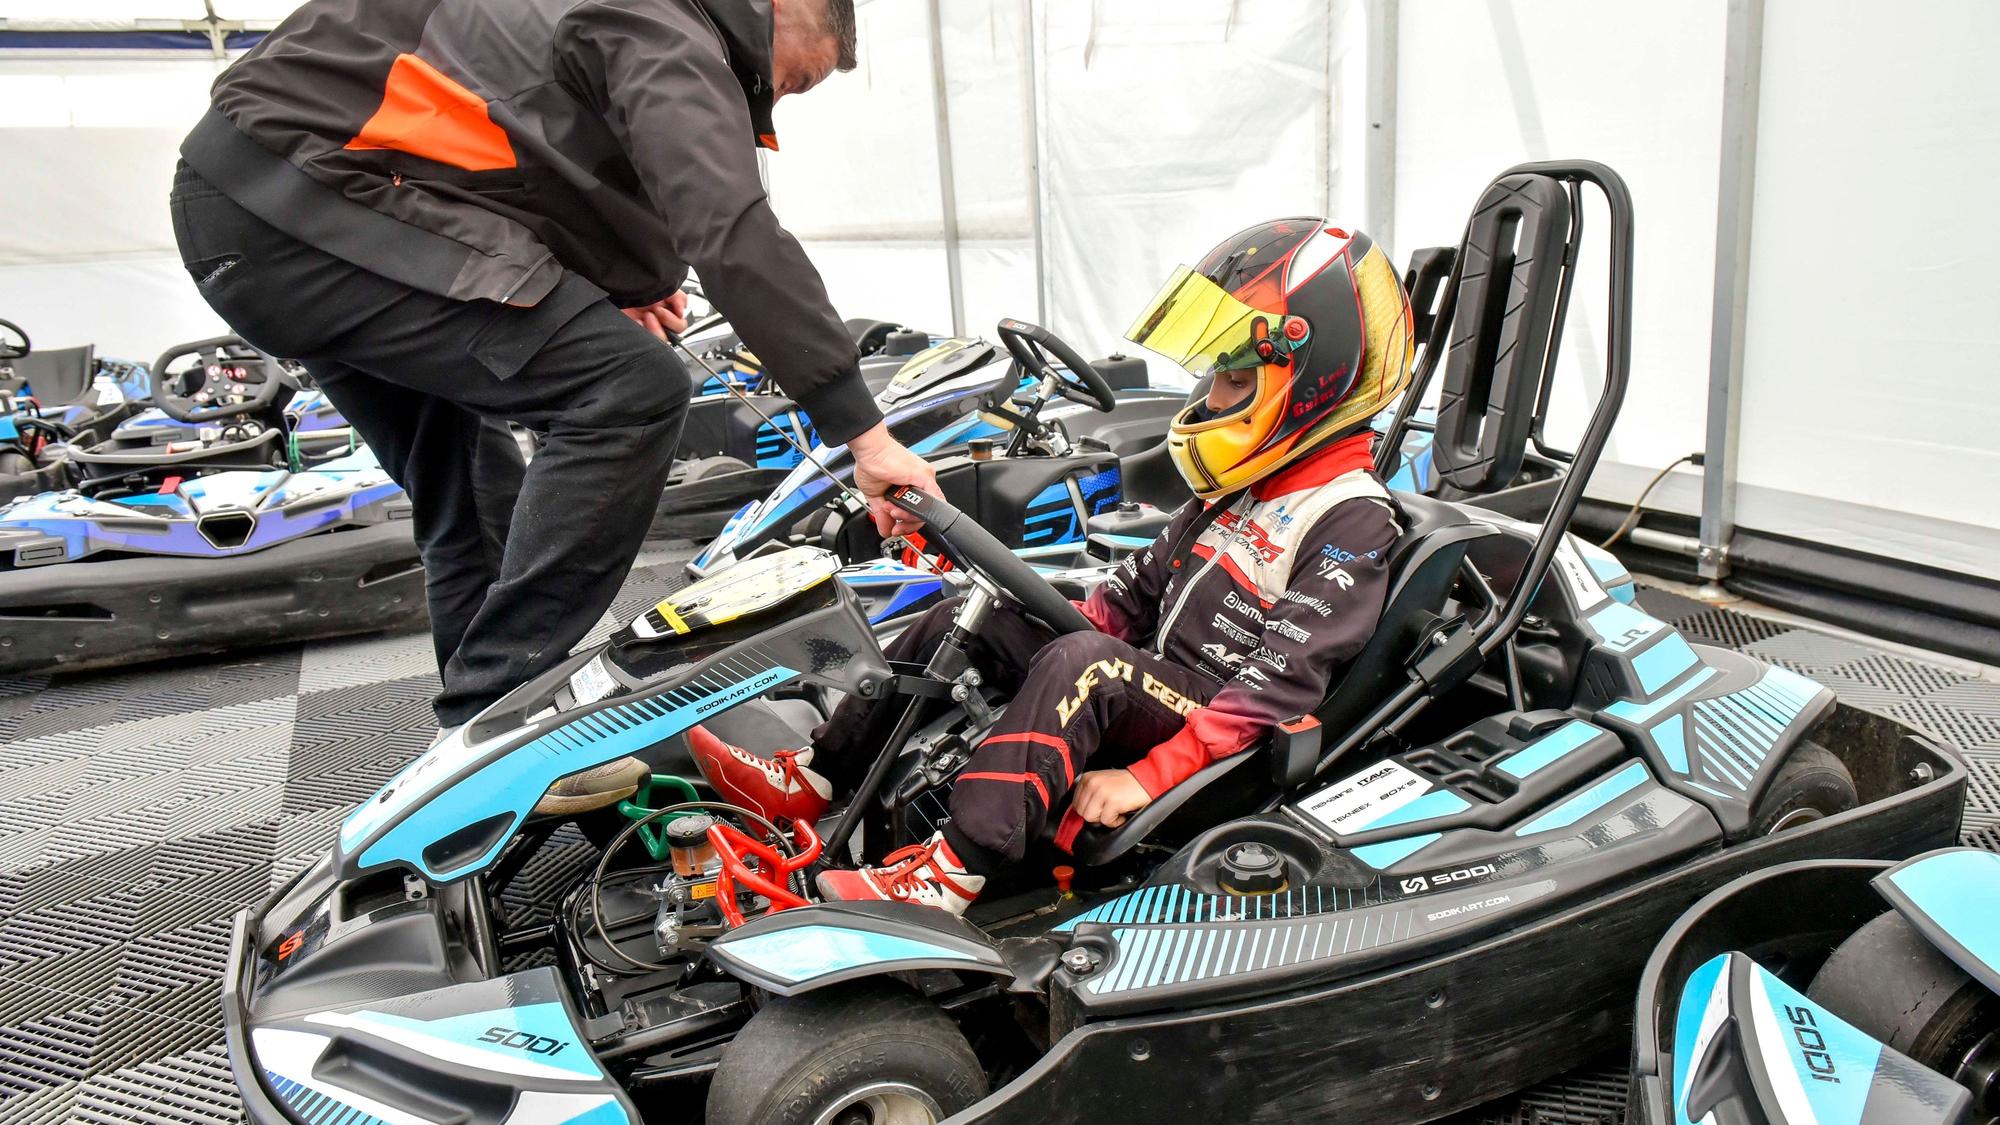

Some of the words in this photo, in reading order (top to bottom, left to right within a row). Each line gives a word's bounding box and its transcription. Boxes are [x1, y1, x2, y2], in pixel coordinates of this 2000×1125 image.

[695, 673, 778, 715] SODIKART.COM
[1356, 767, 1396, 786] ITAKA
[1330, 802, 1372, 824] TEKNEEX
[1431, 863, 1496, 886] SODI
[1426, 895, 1511, 922] SODIKART.COM
